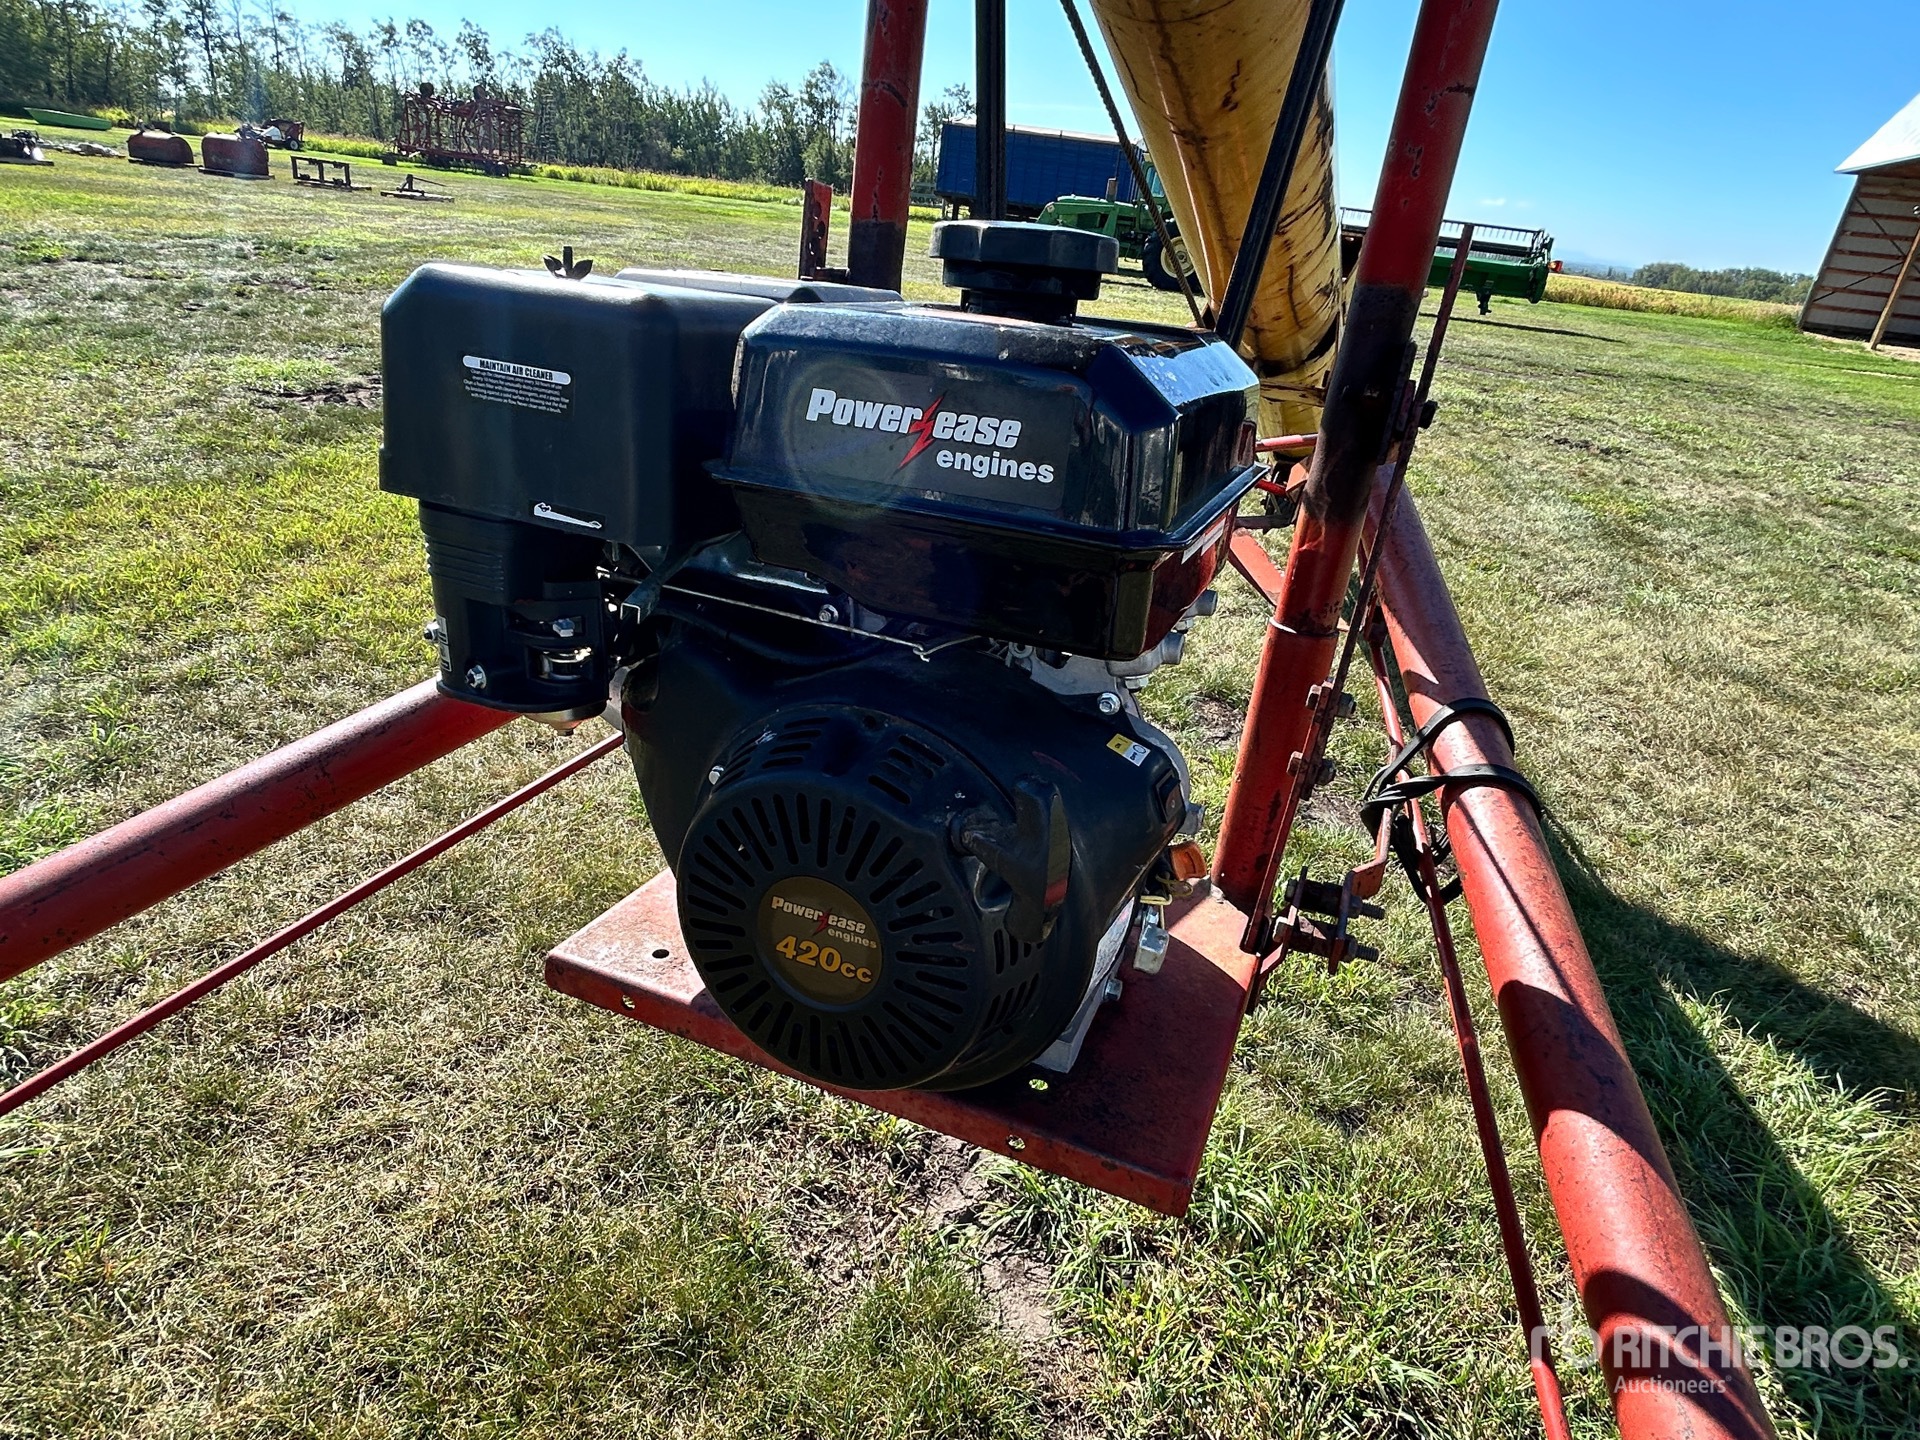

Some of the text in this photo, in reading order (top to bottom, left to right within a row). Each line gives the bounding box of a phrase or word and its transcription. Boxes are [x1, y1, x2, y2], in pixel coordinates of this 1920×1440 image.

[480, 360, 554, 381] MAINTAIN AIR CLEANER
[936, 449, 1055, 484] engines
[828, 928, 877, 949] engines
[776, 935, 872, 983] 420cc
